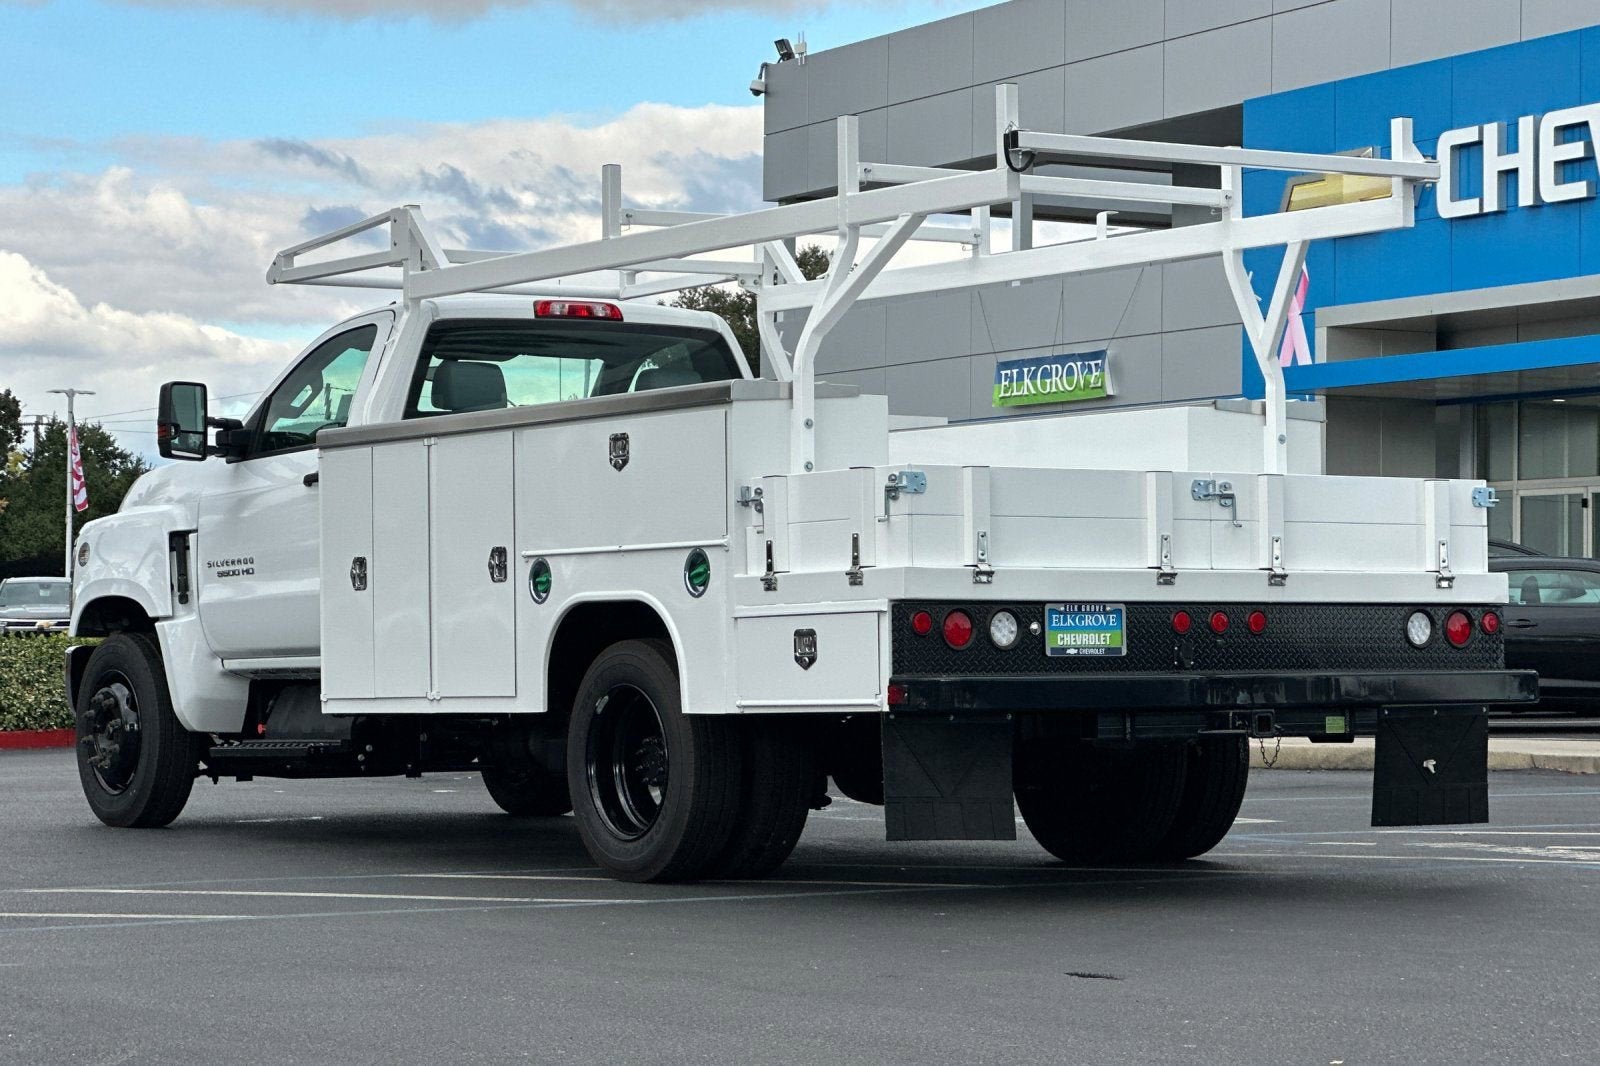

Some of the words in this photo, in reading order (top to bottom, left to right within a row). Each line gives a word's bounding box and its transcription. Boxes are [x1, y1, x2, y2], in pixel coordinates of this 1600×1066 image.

[1436, 102, 1600, 219] CHE
[207, 557, 255, 568] SILVERADO
[241, 567, 255, 576] HD
[1066, 604, 1079, 612] ELK
[1081, 604, 1104, 612] GROVE
[1057, 633, 1112, 646] CHEVROLET
